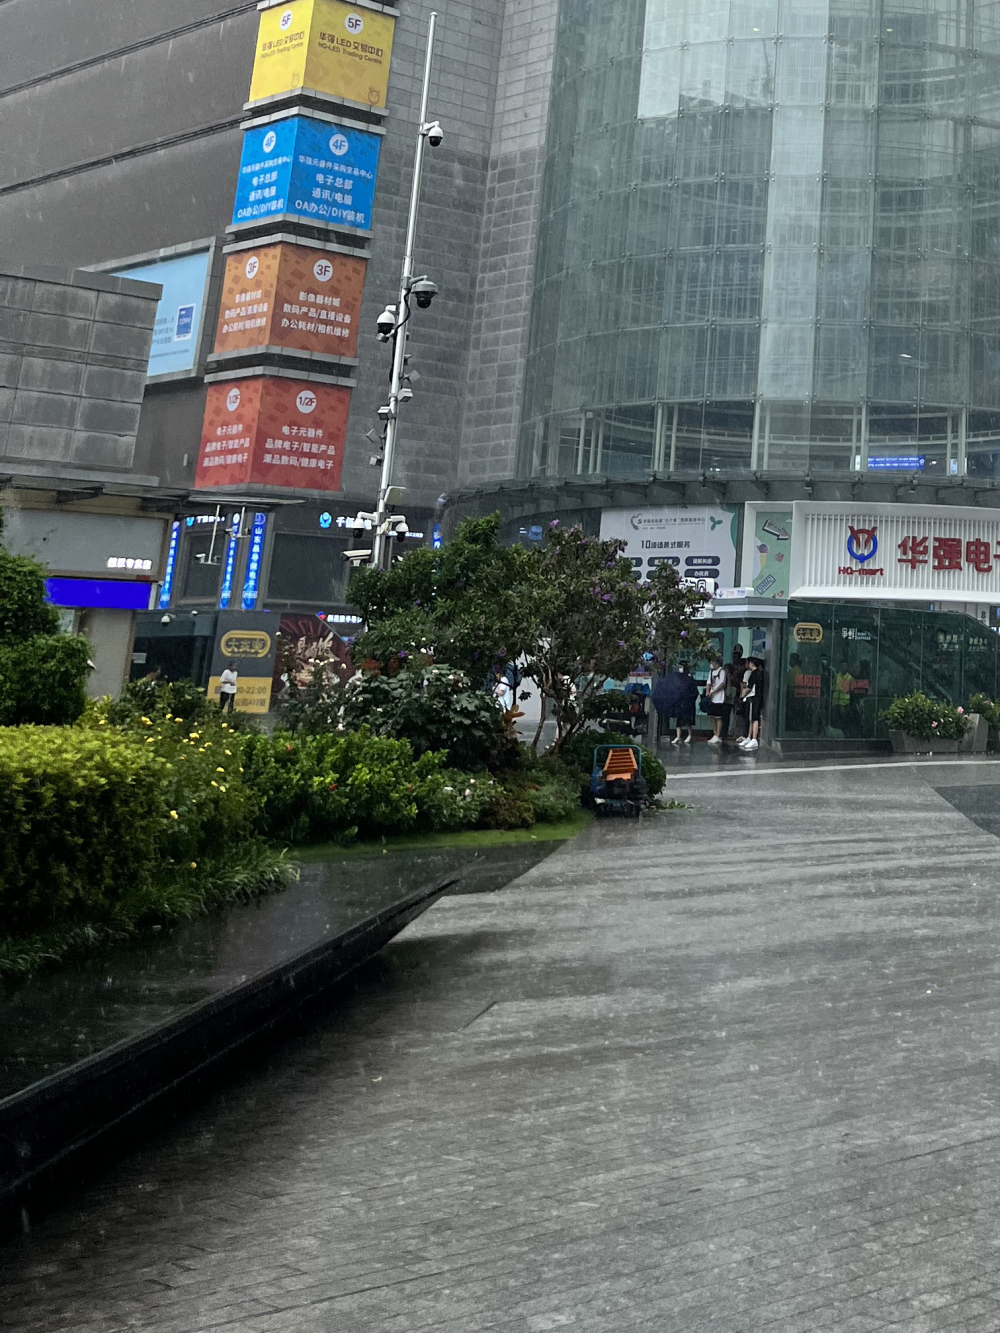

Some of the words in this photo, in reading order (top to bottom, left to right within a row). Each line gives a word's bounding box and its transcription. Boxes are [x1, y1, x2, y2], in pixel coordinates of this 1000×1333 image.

[281, 14, 291, 26] 5F
[347, 17, 361, 29] 5F
[318, 42, 340, 52] HQ-LED
[342, 49, 363, 60] Trading
[364, 55, 382, 65] Centre
[264, 136, 274, 147] 4F
[332, 139, 346, 150] 4F
[299, 155, 373, 179] 华强元器件采购交易中心
[252, 171, 278, 186] 电子总部
[316, 173, 353, 190] 电子总部
[312, 187, 352, 206] 通讯/电脑
[295, 200, 365, 224] OA办公/DIY装机
[248, 261, 257, 274] 3F
[316, 264, 331, 277] 3F
[299, 291, 341, 307] 影像器材城
[283, 303, 351, 324] 数码产品/直播设备
[281, 318, 350, 338] 办公耗材/相机维修
[298, 396, 317, 406] 1/2F
[282, 425, 324, 439] 电子元器件
[265, 439, 335, 455] 品牌电子/智能产品
[263, 454, 334, 470] 潮品数码/健康电子
[838, 566, 884, 577] HQ-mart
